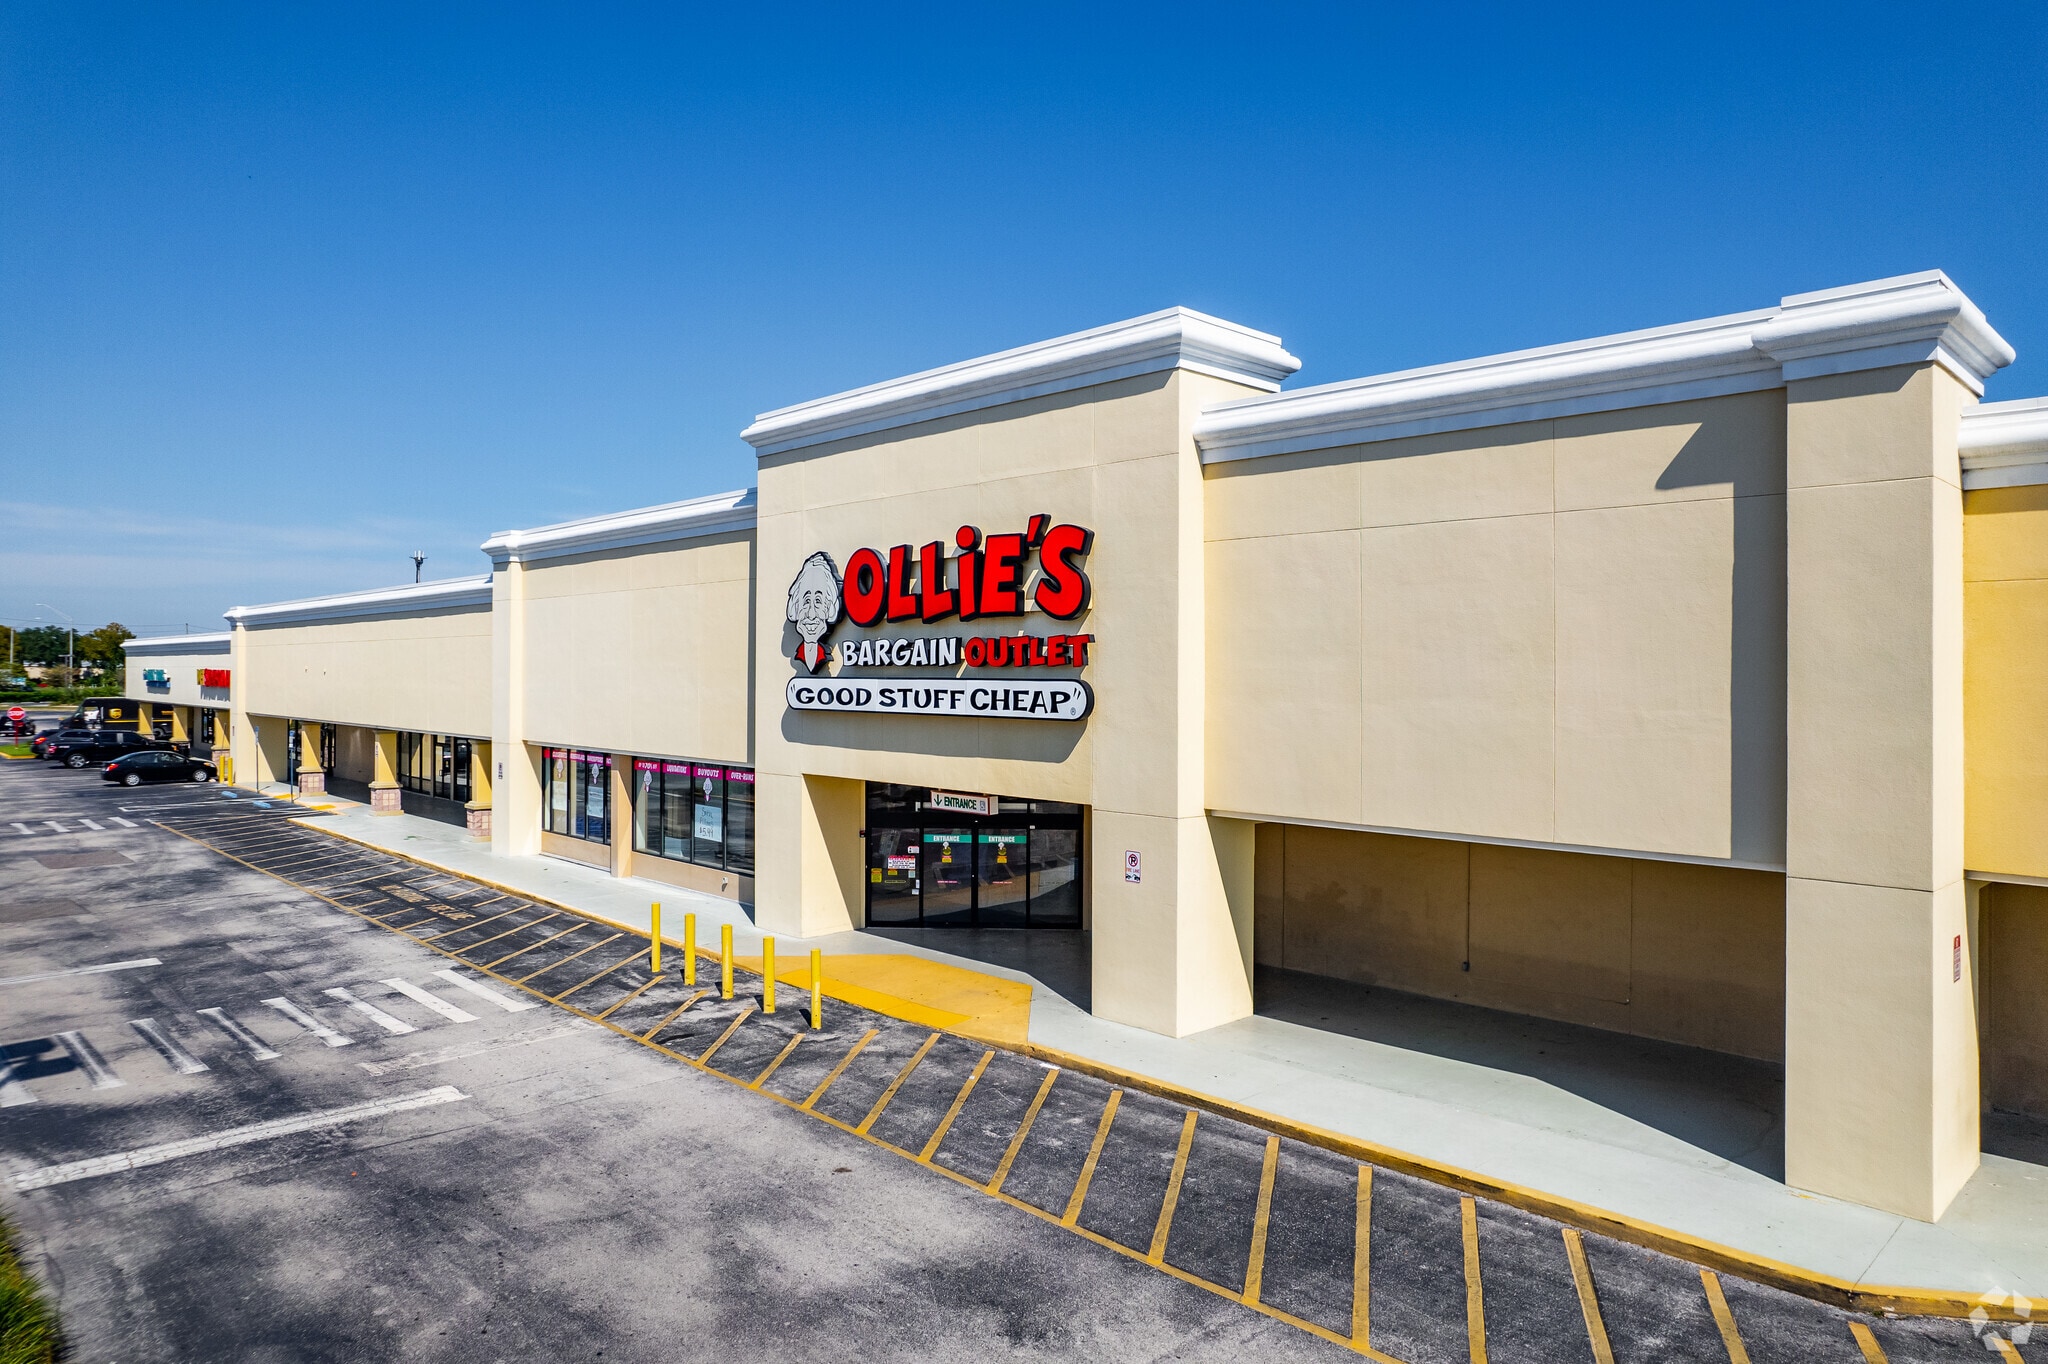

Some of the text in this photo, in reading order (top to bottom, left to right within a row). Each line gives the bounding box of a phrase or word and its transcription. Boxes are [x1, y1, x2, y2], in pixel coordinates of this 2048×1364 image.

[842, 634, 1095, 668] BARGAIN OUTLET
[879, 687, 965, 710] STUFF
[943, 796, 977, 810] ENTRANCE
